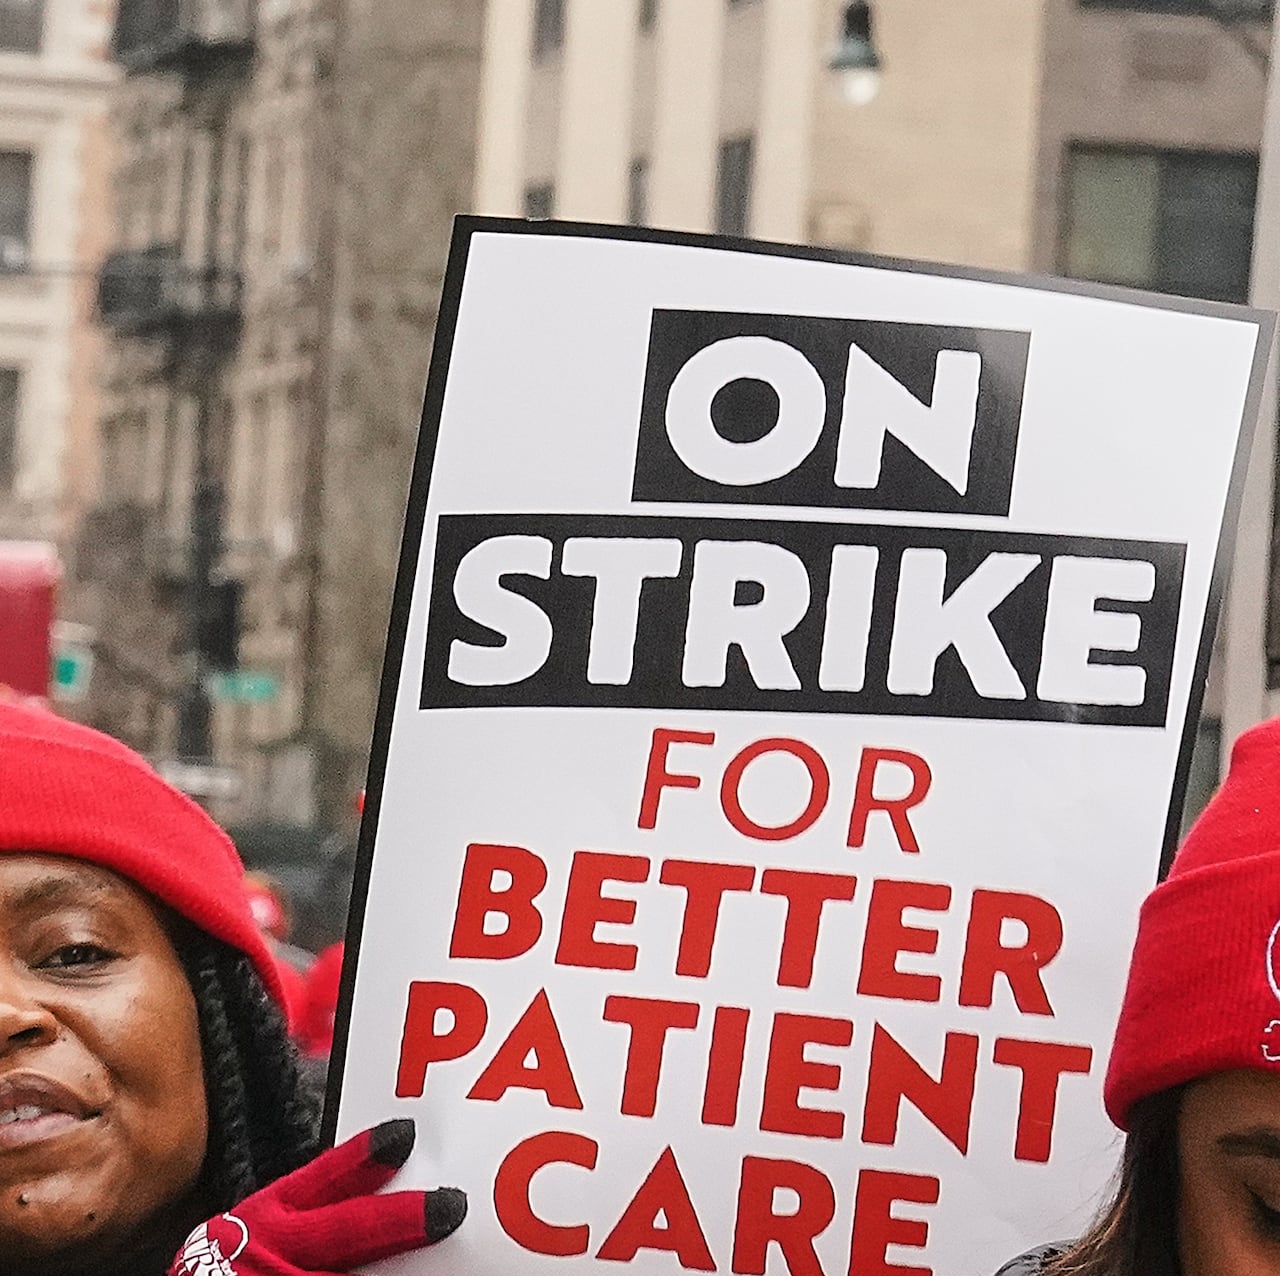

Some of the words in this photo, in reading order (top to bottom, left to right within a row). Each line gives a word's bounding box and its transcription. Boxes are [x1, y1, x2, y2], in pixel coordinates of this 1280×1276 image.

[665, 334, 982, 496] ON
[446, 534, 1157, 706] STRIKE
[638, 727, 933, 854] FOR
[448, 843, 1064, 1016] BETTER
[395, 980, 1093, 1164] PATIENT
